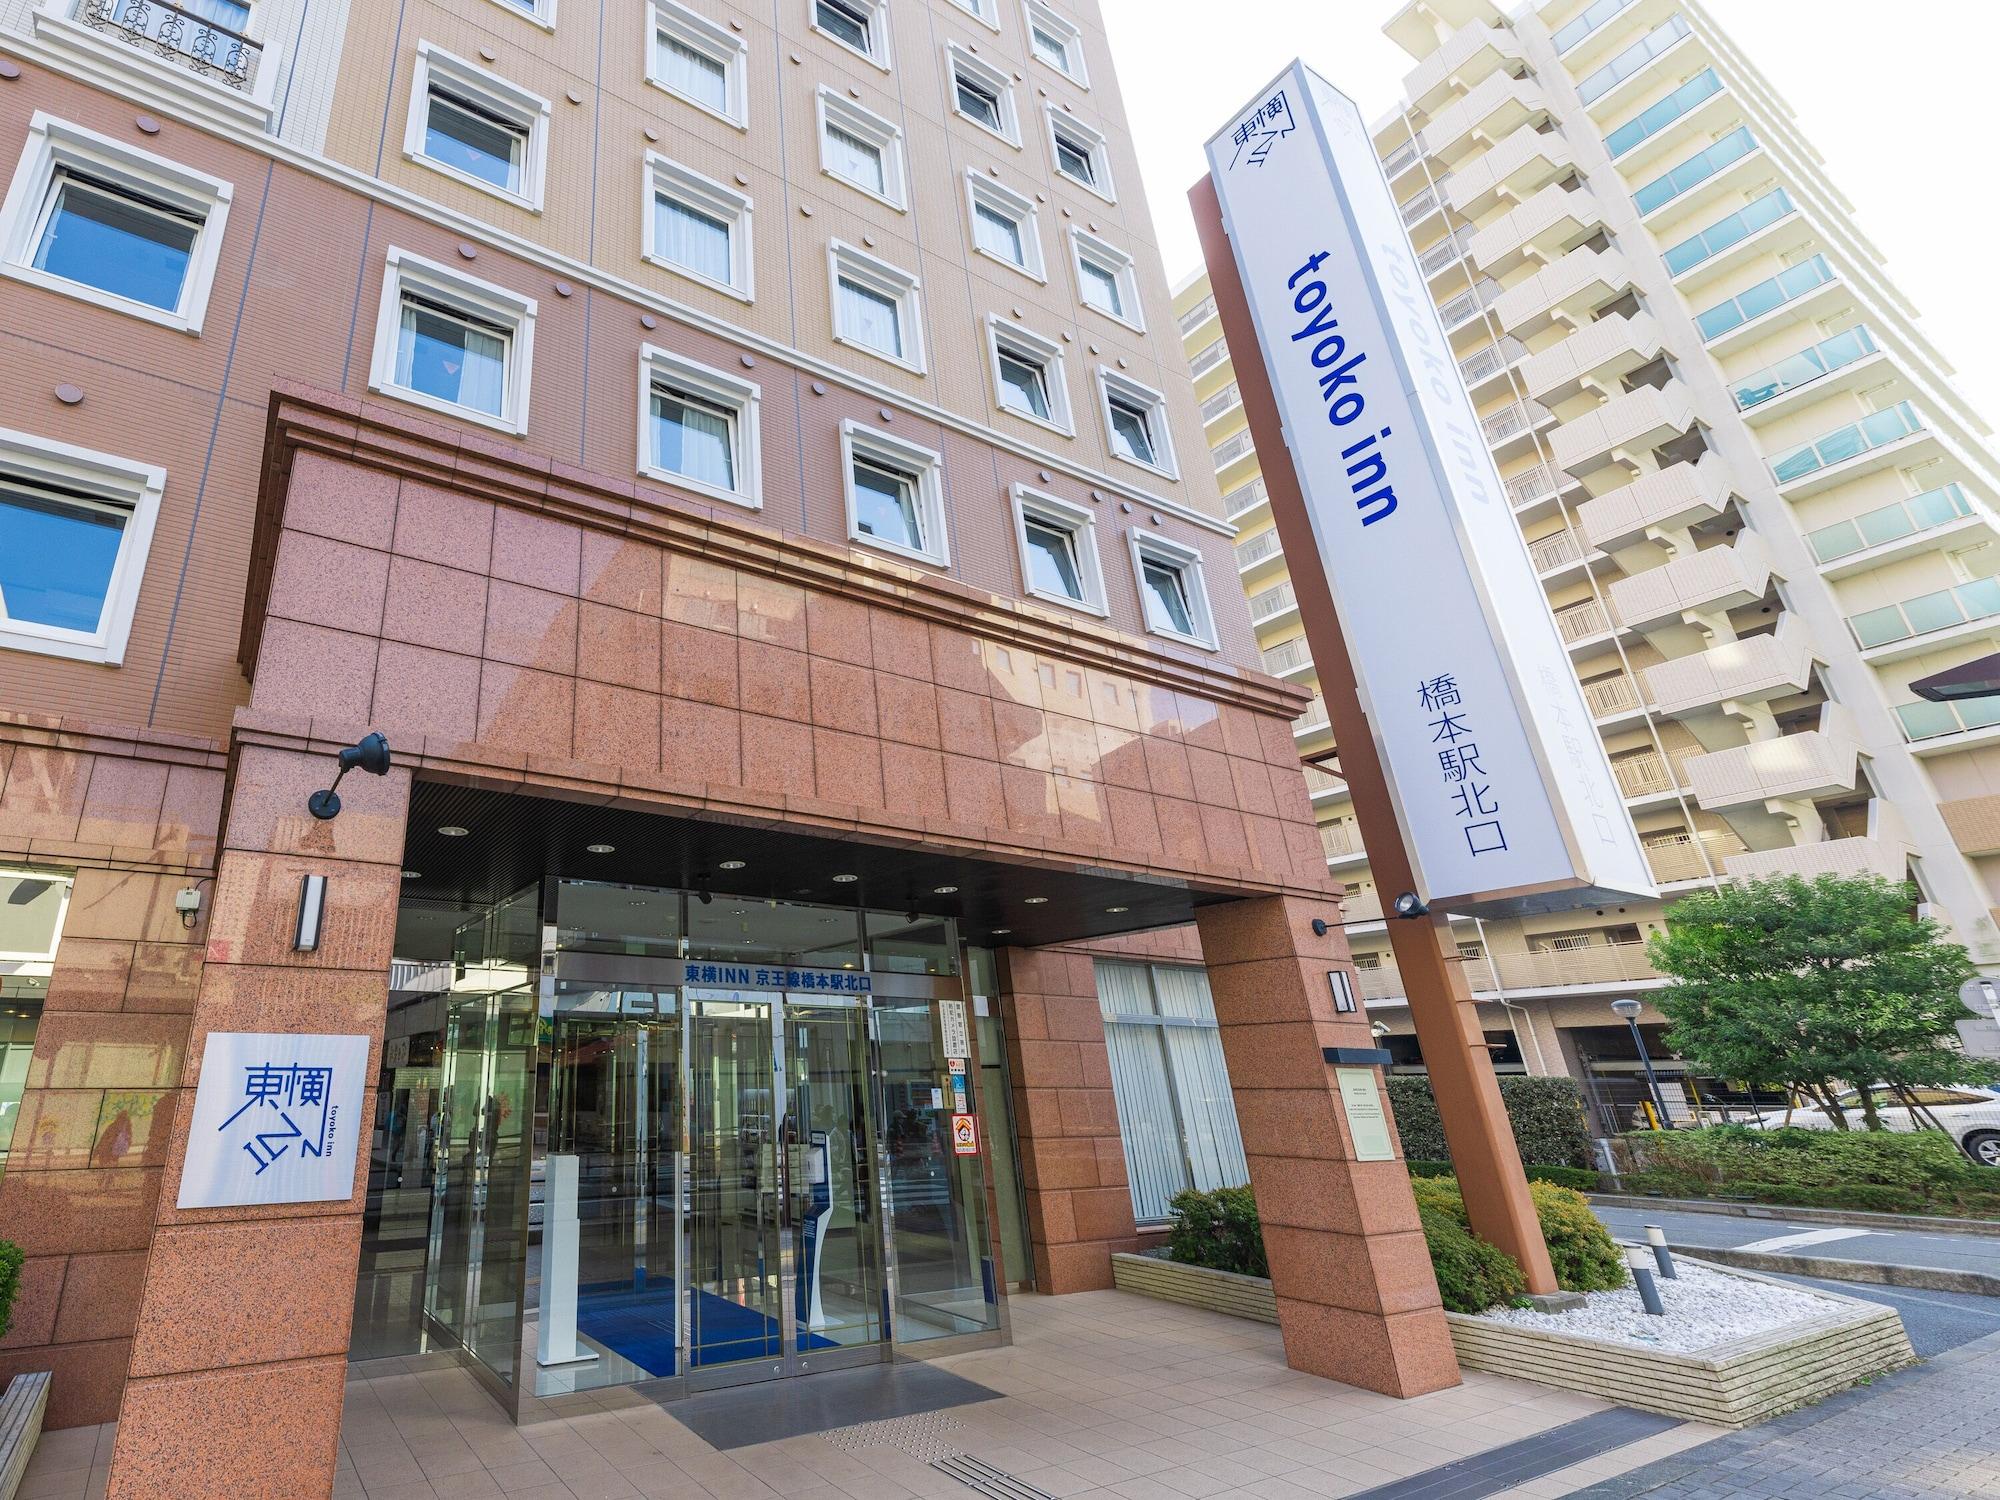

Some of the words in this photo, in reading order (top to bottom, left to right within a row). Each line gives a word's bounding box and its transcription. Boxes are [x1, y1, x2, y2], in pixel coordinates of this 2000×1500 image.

[1287, 250, 1367, 426] toyoko
[1340, 426, 1399, 527] inn
[1380, 242, 1452, 406] toyoko
[1445, 420, 1490, 505] inn
[1416, 672, 1508, 857] 橋本駅北口
[684, 964, 750, 985] 東横INN
[755, 968, 872, 992] 京王線橋本駅北口
[326, 1141, 335, 1157] inn
[328, 1105, 339, 1139] toyoko
